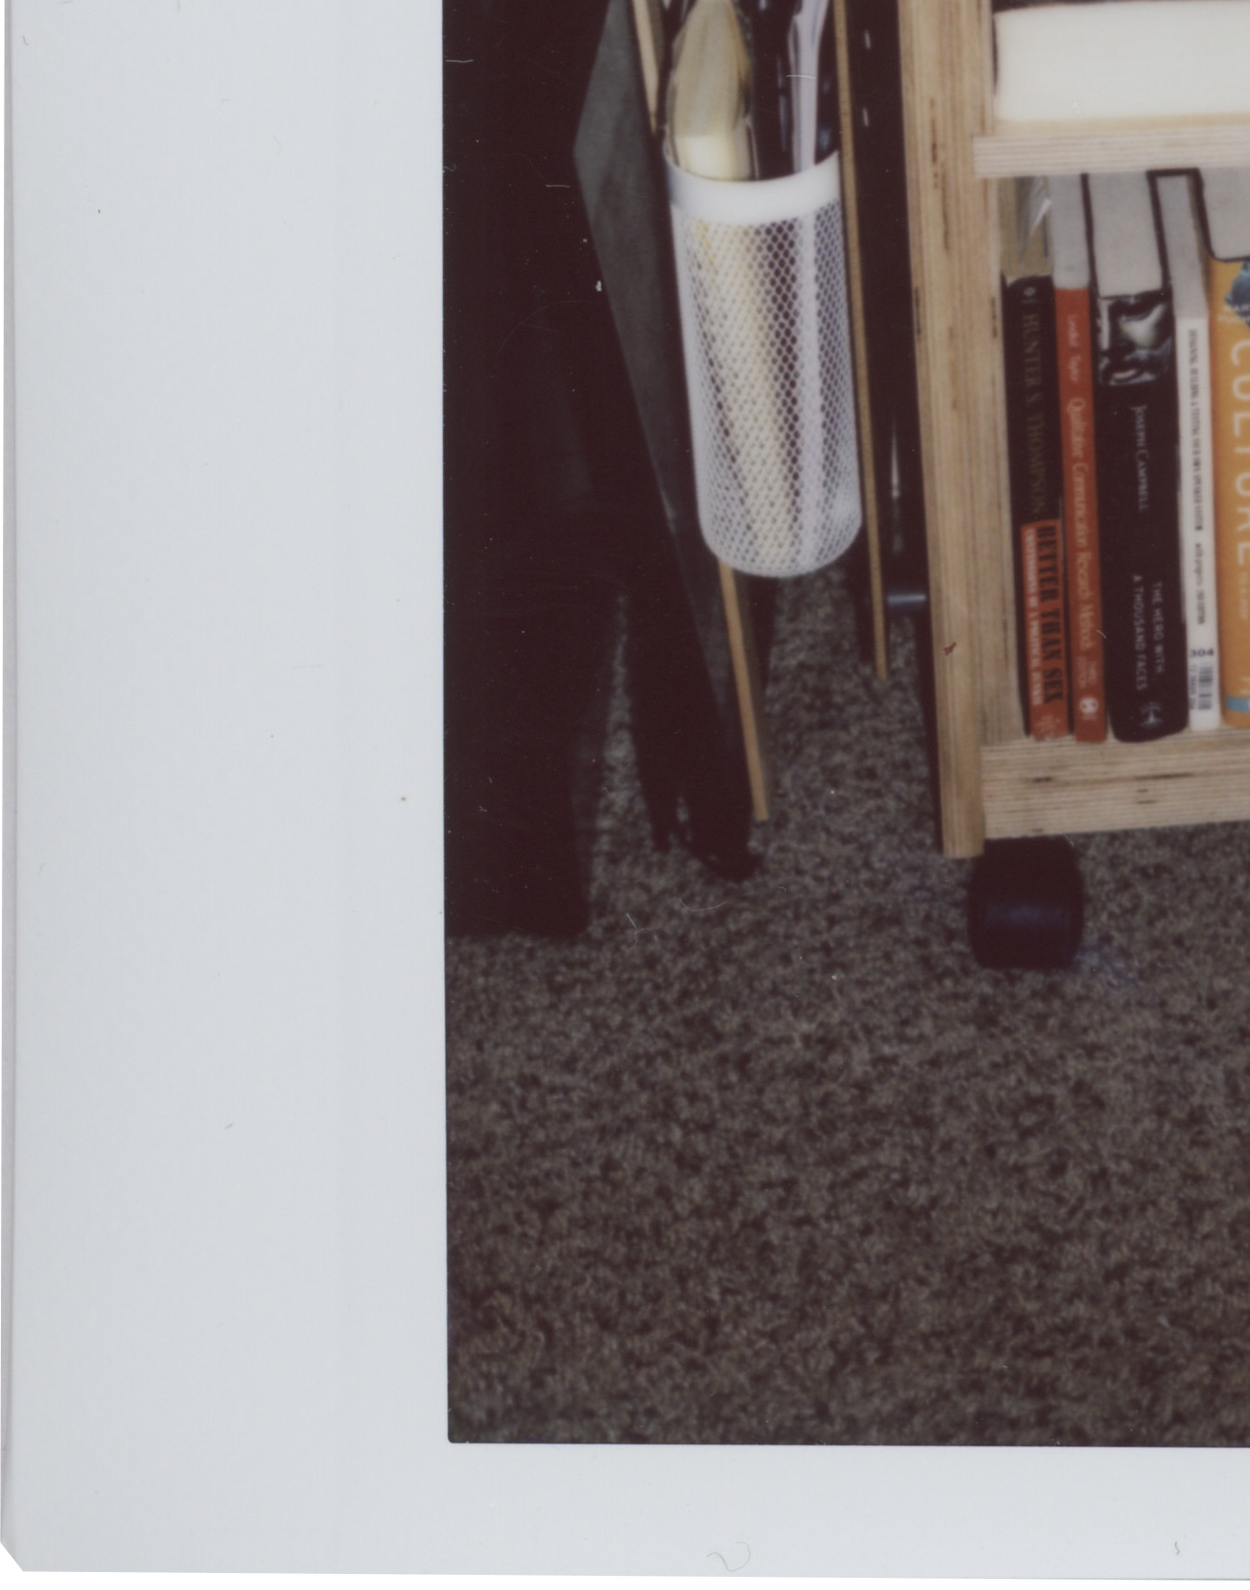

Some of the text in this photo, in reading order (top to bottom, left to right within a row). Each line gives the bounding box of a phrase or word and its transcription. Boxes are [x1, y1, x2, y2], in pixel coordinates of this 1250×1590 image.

[1023, 313, 1042, 388] HUNTER
[1027, 412, 1046, 514] THOMPSON
[1068, 398, 1096, 652] Qualitative Communication Research Methods
[1037, 525, 1065, 704] BETTER THAN SEX
[1133, 574, 1148, 691] A THOUSAND FACES
[1152, 581, 1165, 674] THE HERO WITH
[1189, 646, 1214, 658] 304
